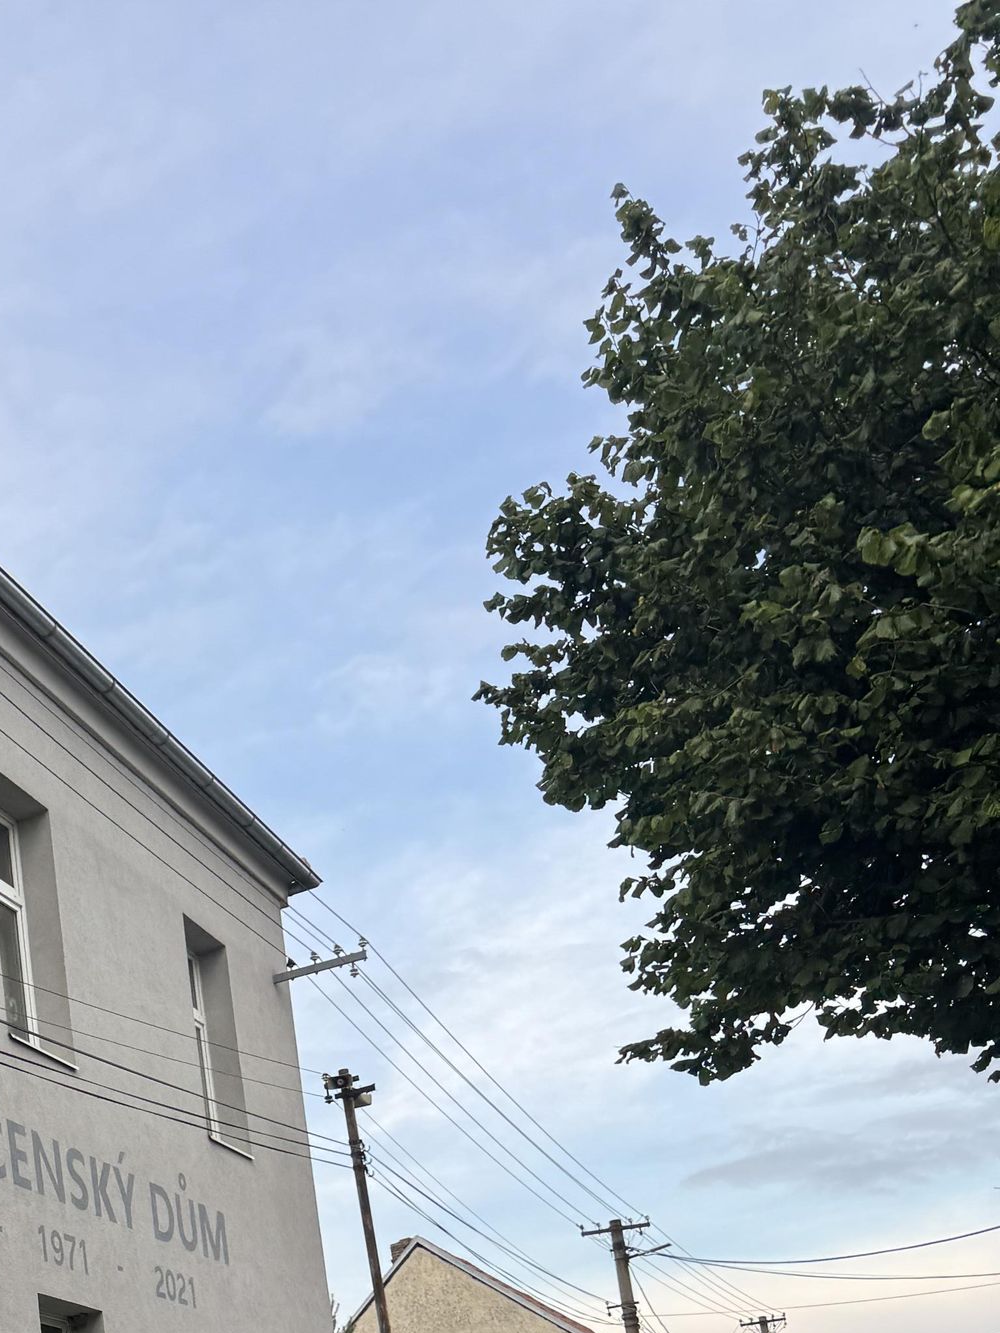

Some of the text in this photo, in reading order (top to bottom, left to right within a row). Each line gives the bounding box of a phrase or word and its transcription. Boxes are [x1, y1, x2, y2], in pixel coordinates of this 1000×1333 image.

[149, 1173, 230, 1265] DŮM
[38, 1225, 89, 1275] 1971
[155, 1266, 197, 1308] 2021
